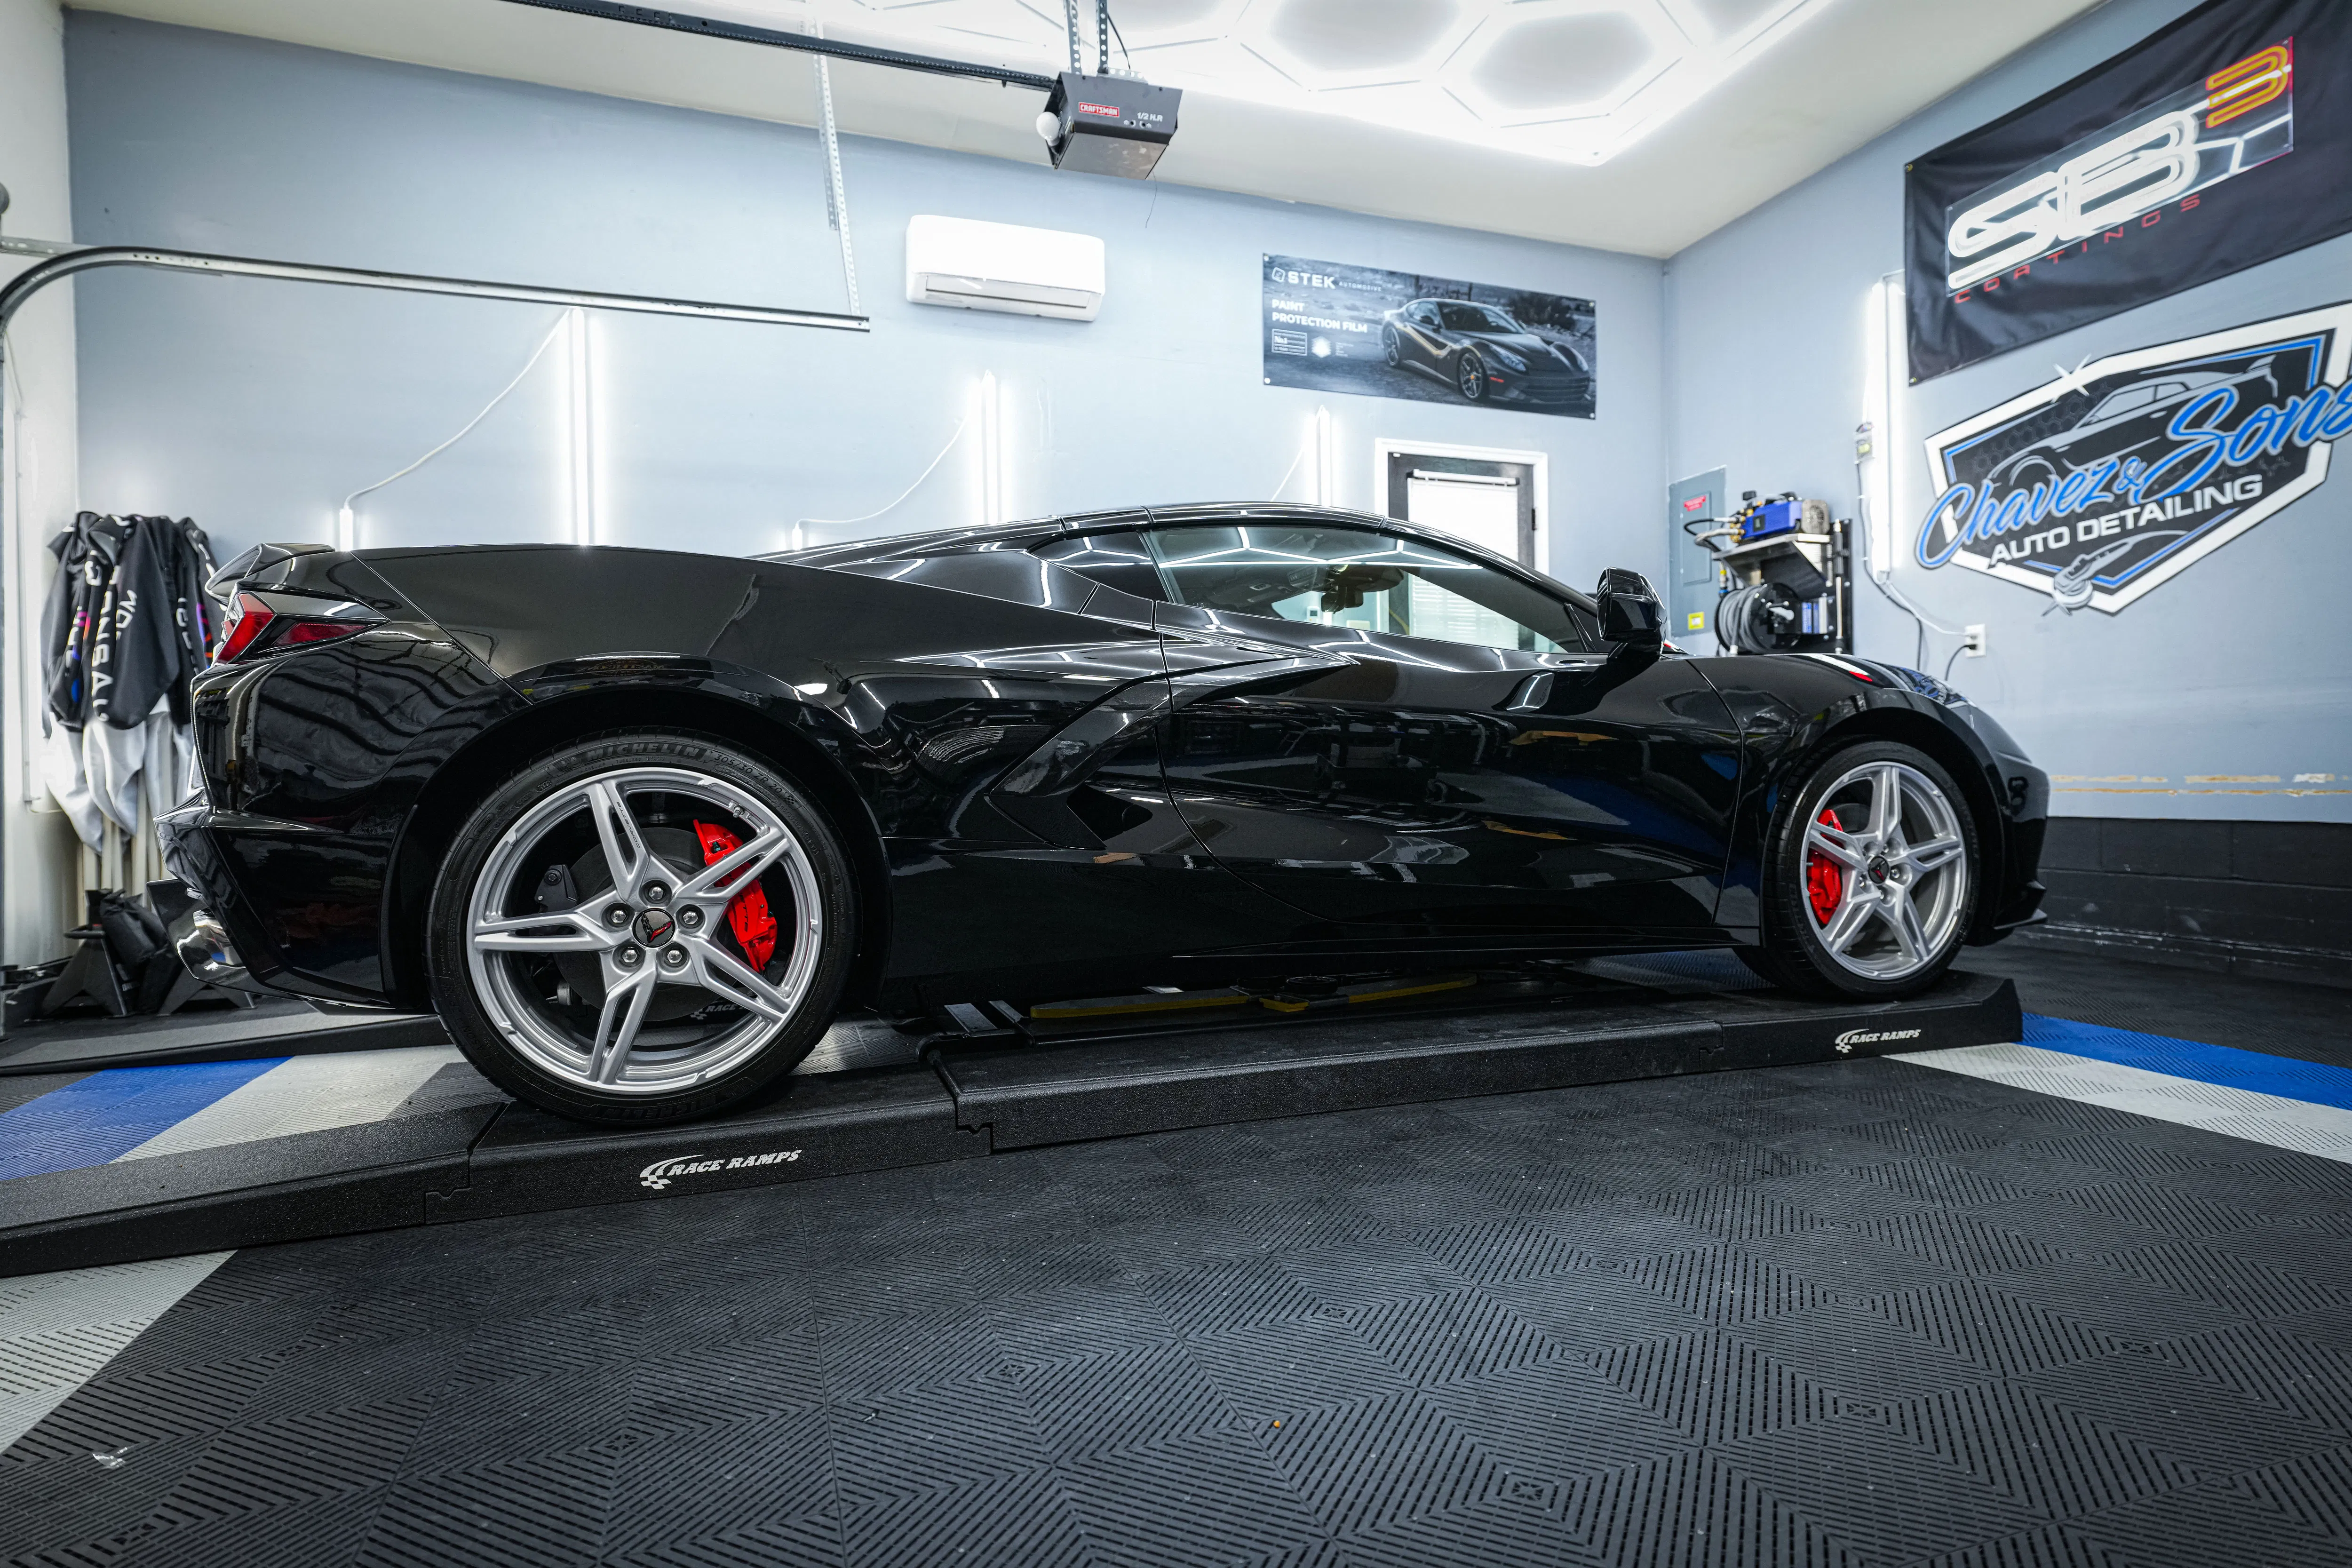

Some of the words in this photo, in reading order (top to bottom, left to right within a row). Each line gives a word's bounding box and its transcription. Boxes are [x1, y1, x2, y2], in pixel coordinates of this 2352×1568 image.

[1080, 104, 1118, 116] CRAFTSMAN
[1955, 194, 2200, 304] COATINGS
[1288, 271, 1336, 289] STEK
[1339, 281, 1382, 292] AUTOMOTIVE
[1271, 299, 1305, 311] PAINT
[1272, 312, 1340, 329] PROTECTION
[1343, 321, 1367, 333] FILM
[2130, 380, 2352, 505] Sons
[2113, 455, 2148, 495] &
[1916, 456, 2121, 567] Chavez
[1987, 523, 2070, 569] AUTO
[2077, 473, 2263, 542] DETAILING
[589, 742, 701, 761] MICHELIN
[714, 754, 754, 774] 305/30
[753, 772, 769, 783] ZR
[768, 783, 783, 793] 20
[616, 801, 641, 848] CORVETTE
[705, 1004, 738, 1012] RACE
[1850, 1033, 1881, 1043] RACE
[1880, 1029, 1922, 1041] RAMPS
[667, 1159, 726, 1176] RACE
[726, 1149, 803, 1170] RAMPS
